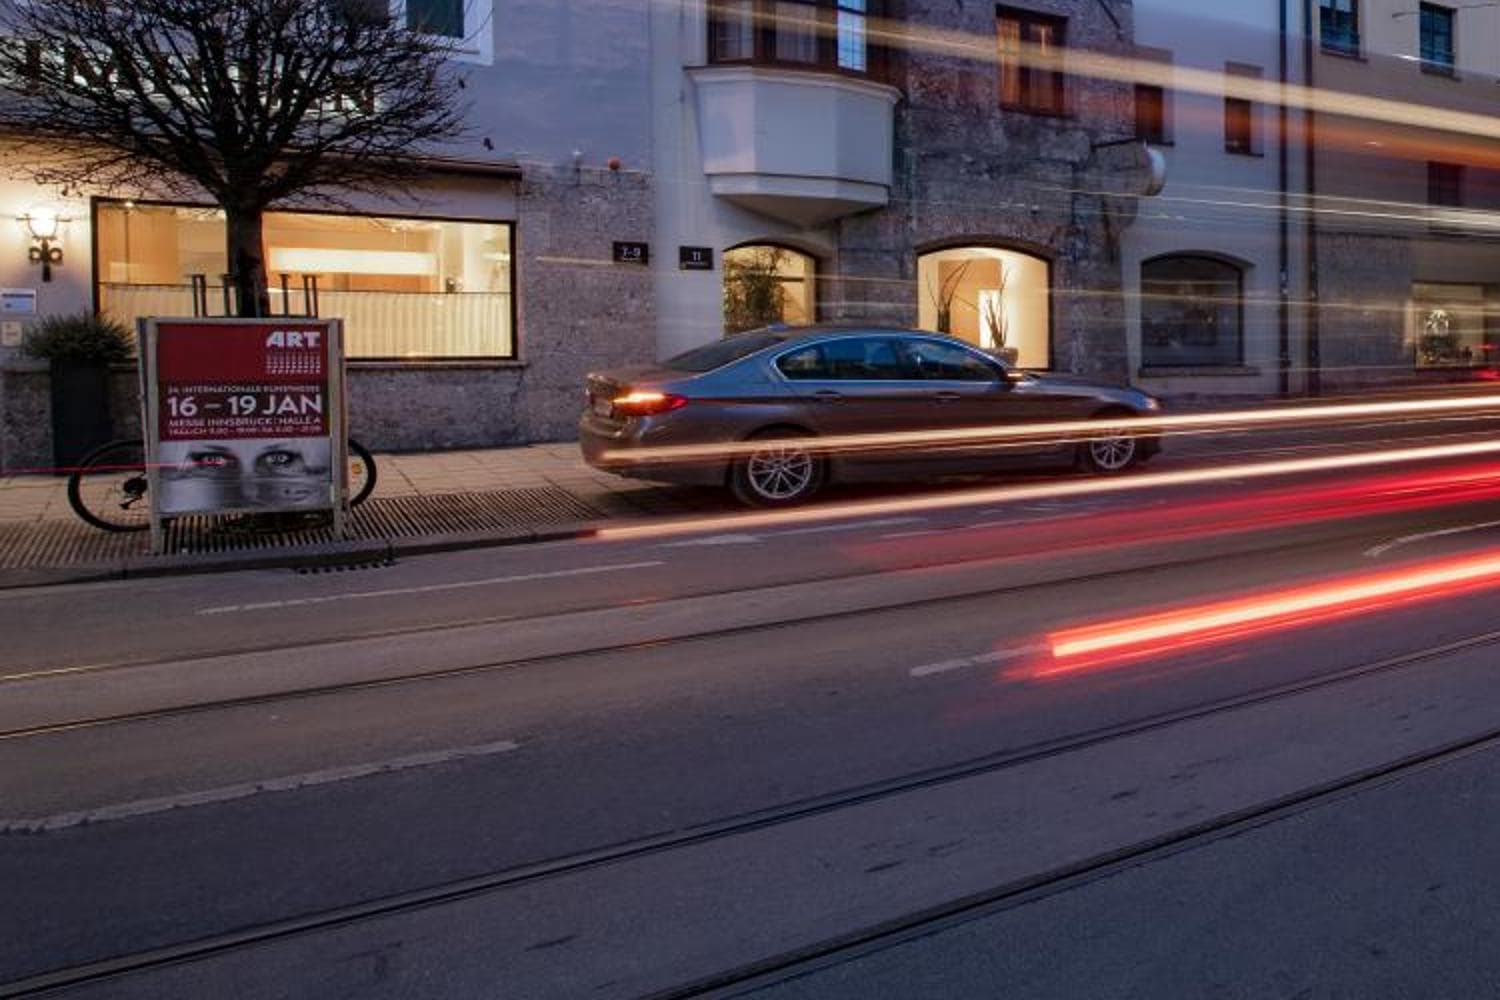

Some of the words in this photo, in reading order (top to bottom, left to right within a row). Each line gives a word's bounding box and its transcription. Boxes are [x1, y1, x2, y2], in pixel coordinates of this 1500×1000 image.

[266, 331, 321, 348] ART
[167, 396, 199, 417] 16
[227, 394, 257, 415] 19
[261, 394, 322, 415] JAN
[169, 419, 205, 427] MESSE
[207, 417, 273, 427] INNSBRUCK
[278, 416, 311, 425] HALLE
